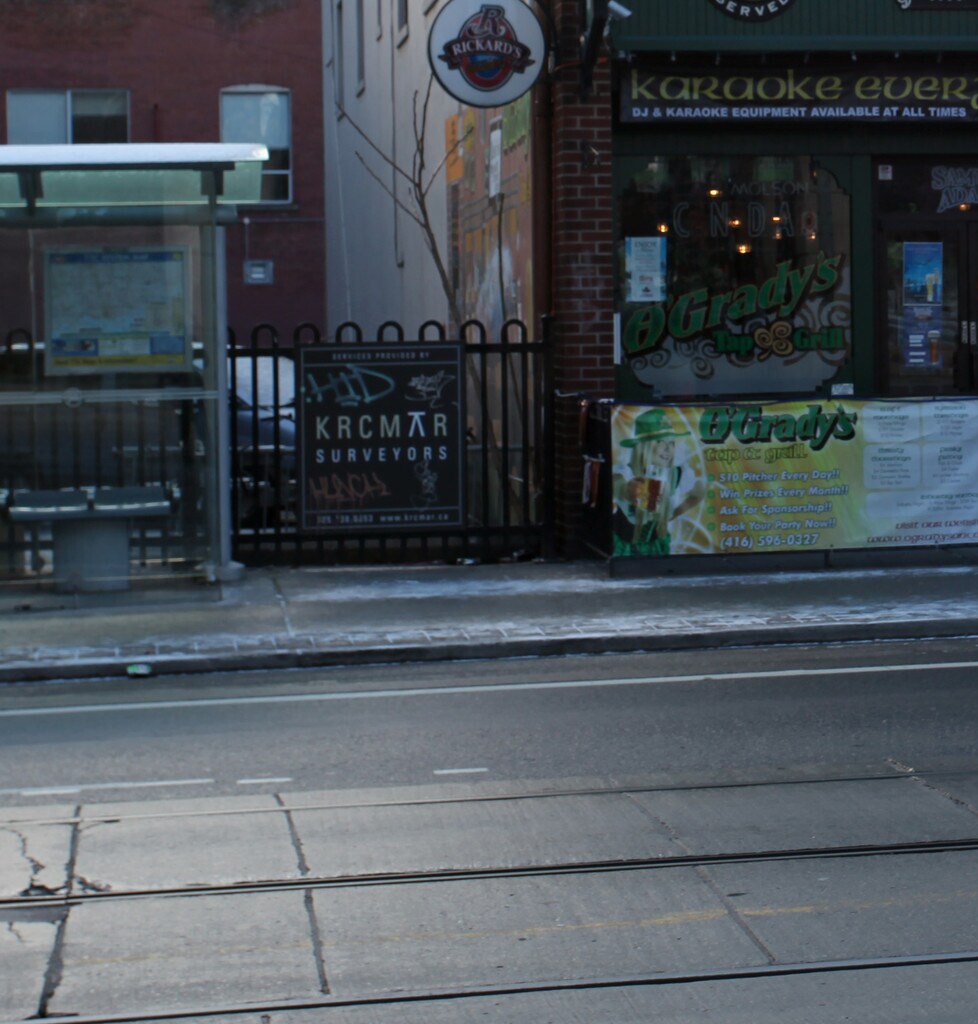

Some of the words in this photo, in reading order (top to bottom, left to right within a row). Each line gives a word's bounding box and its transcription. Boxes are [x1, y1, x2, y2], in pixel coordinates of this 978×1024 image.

[451, 39, 523, 59] RICKARD'S
[632, 107, 650, 118] DJ
[652, 107, 662, 118] &
[666, 107, 729, 118] KARAOKE
[732, 107, 808, 118] EQUIPMENT
[810, 106, 880, 118] AVAILABLE
[883, 106, 900, 117] AT
[902, 106, 926, 117] ALL
[928, 106, 967, 118] TIMES
[730, 181, 809, 196] MOLSON
[622, 249, 843, 354] O'Grady's
[713, 330, 754, 356] Tap
[792, 326, 845, 351] Grill
[315, 412, 448, 440] KRCMAR
[699, 403, 857, 451] O'Grady's
[315, 446, 448, 464] SURVEYORS
[742, 471, 778, 482] Pitcher
[781, 470, 809, 482] Every
[719, 489, 740, 499] Win
[743, 488, 775, 498] Prizes
[778, 487, 806, 498] Every
[809, 485, 849, 496] Month!!
[719, 505, 738, 516] Ask
[741, 505, 758, 515] For
[719, 521, 746, 532] Book
[750, 520, 771, 531] Your
[775, 519, 802, 532] Party
[719, 535, 753, 549] (416)
[758, 533, 819, 547] 596-0327
